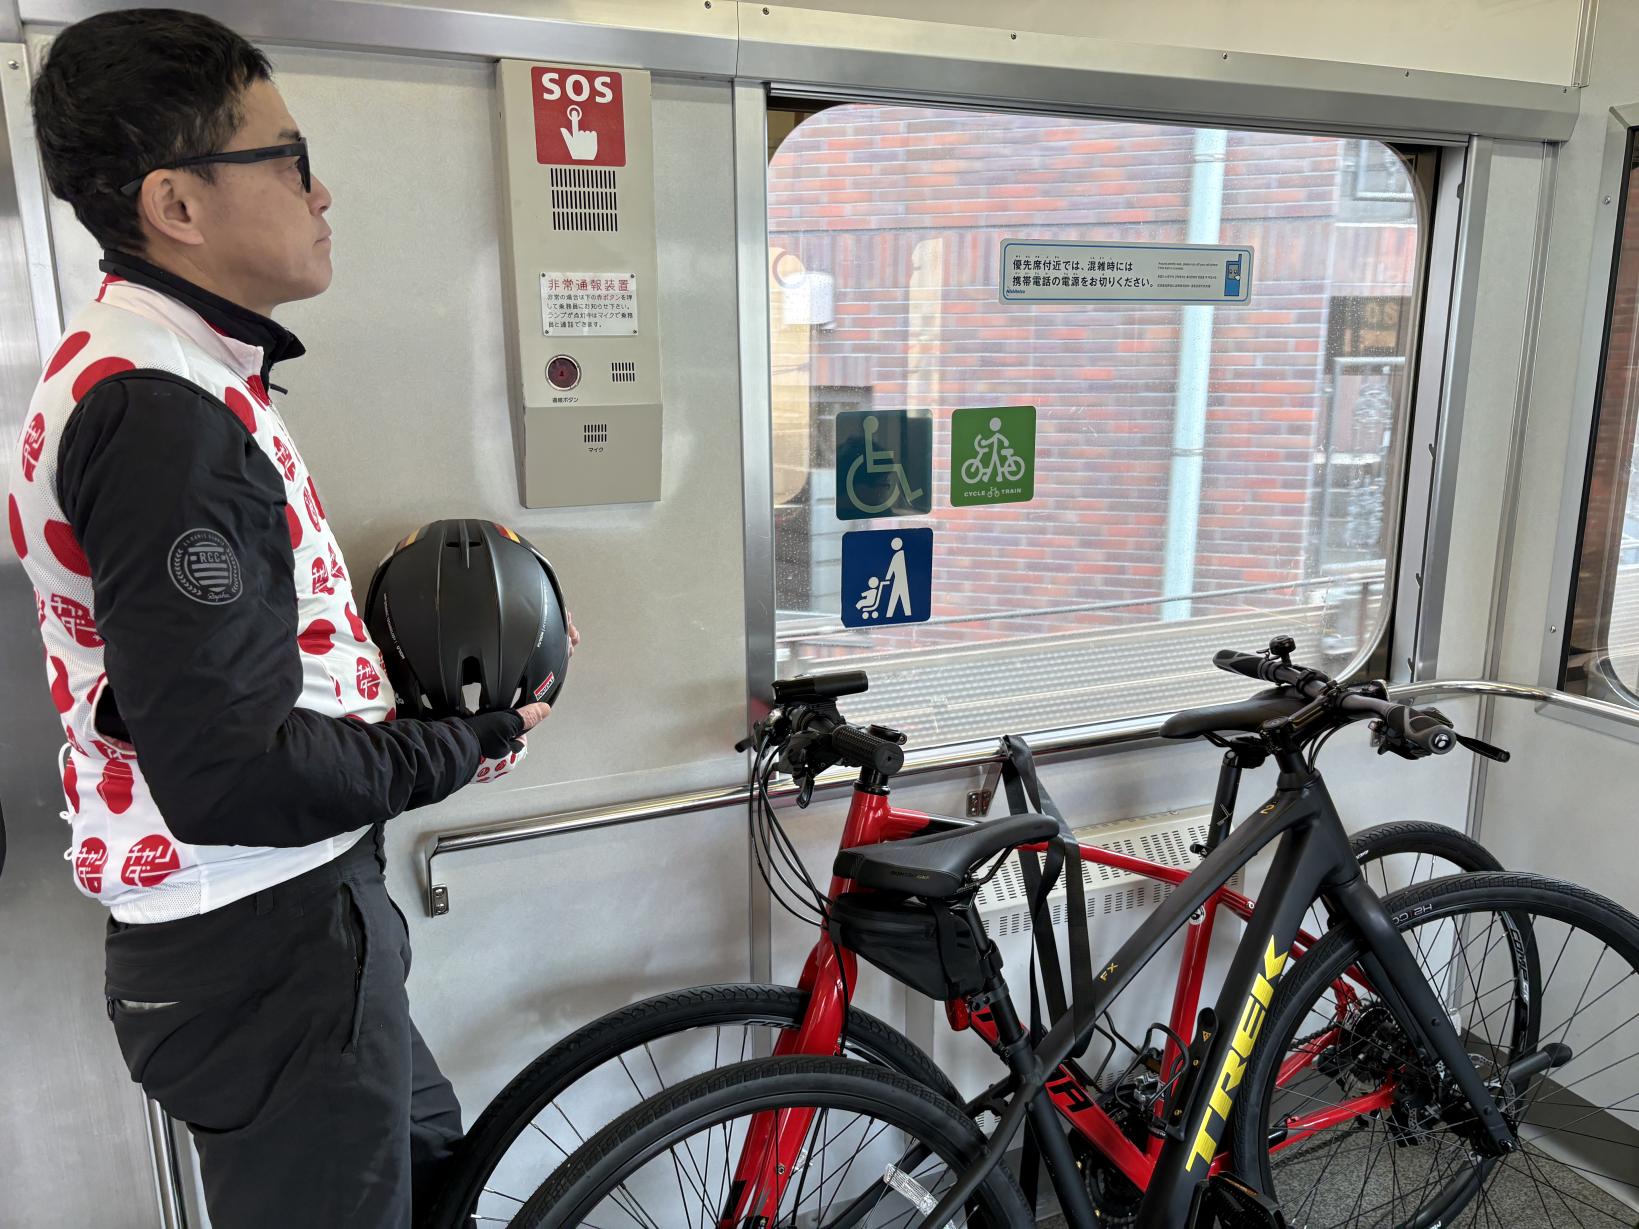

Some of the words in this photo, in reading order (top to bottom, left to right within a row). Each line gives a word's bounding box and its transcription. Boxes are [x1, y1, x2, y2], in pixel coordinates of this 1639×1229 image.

[541, 72, 613, 104] SOS
[1012, 259, 1134, 272] 優先席付近では、混雑時には
[547, 278, 630, 292] 非常通報装置
[1012, 275, 1154, 288] 携帯電話の電源をお切りください。
[199, 552, 221, 563] RCC
[127, 844, 174, 865] チャリ
[126, 864, 180, 887] ダー
[1099, 962, 1119, 982] FX
[1185, 935, 1289, 1172] TREK
